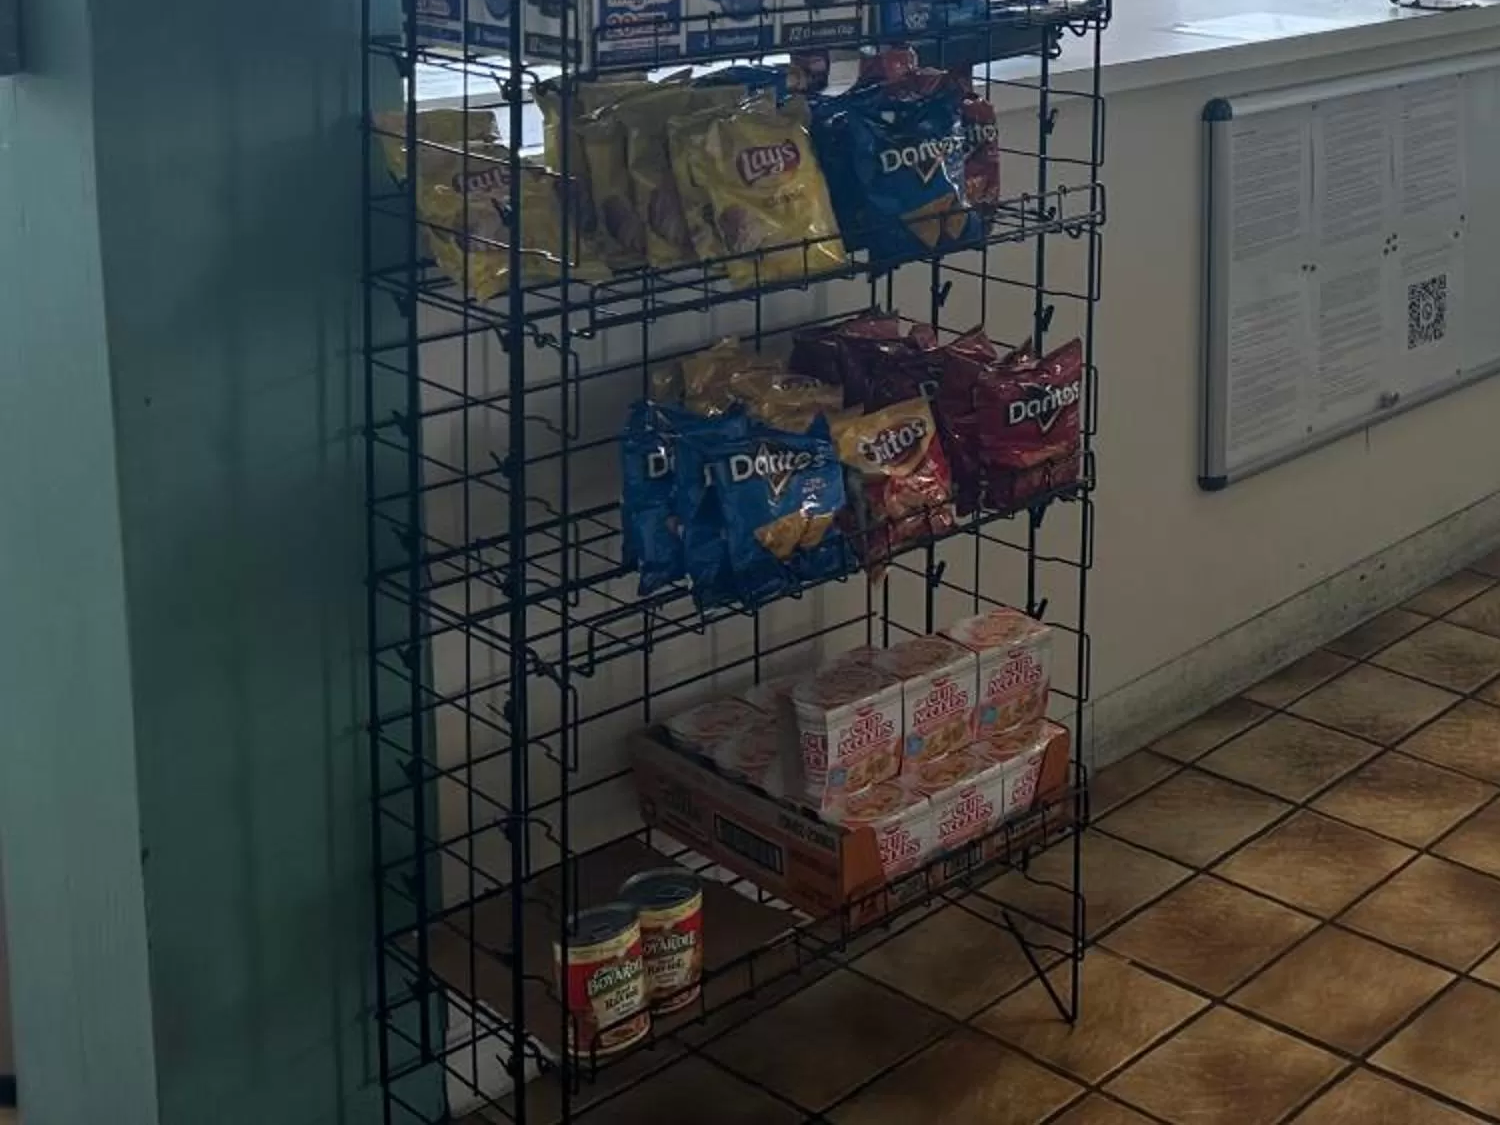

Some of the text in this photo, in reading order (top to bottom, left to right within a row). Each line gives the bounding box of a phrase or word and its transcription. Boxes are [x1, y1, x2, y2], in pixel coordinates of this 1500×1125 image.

[1009, 381, 1080, 425] Doritos
[857, 418, 926, 465] Fritos
[729, 449, 827, 482] Doritos
